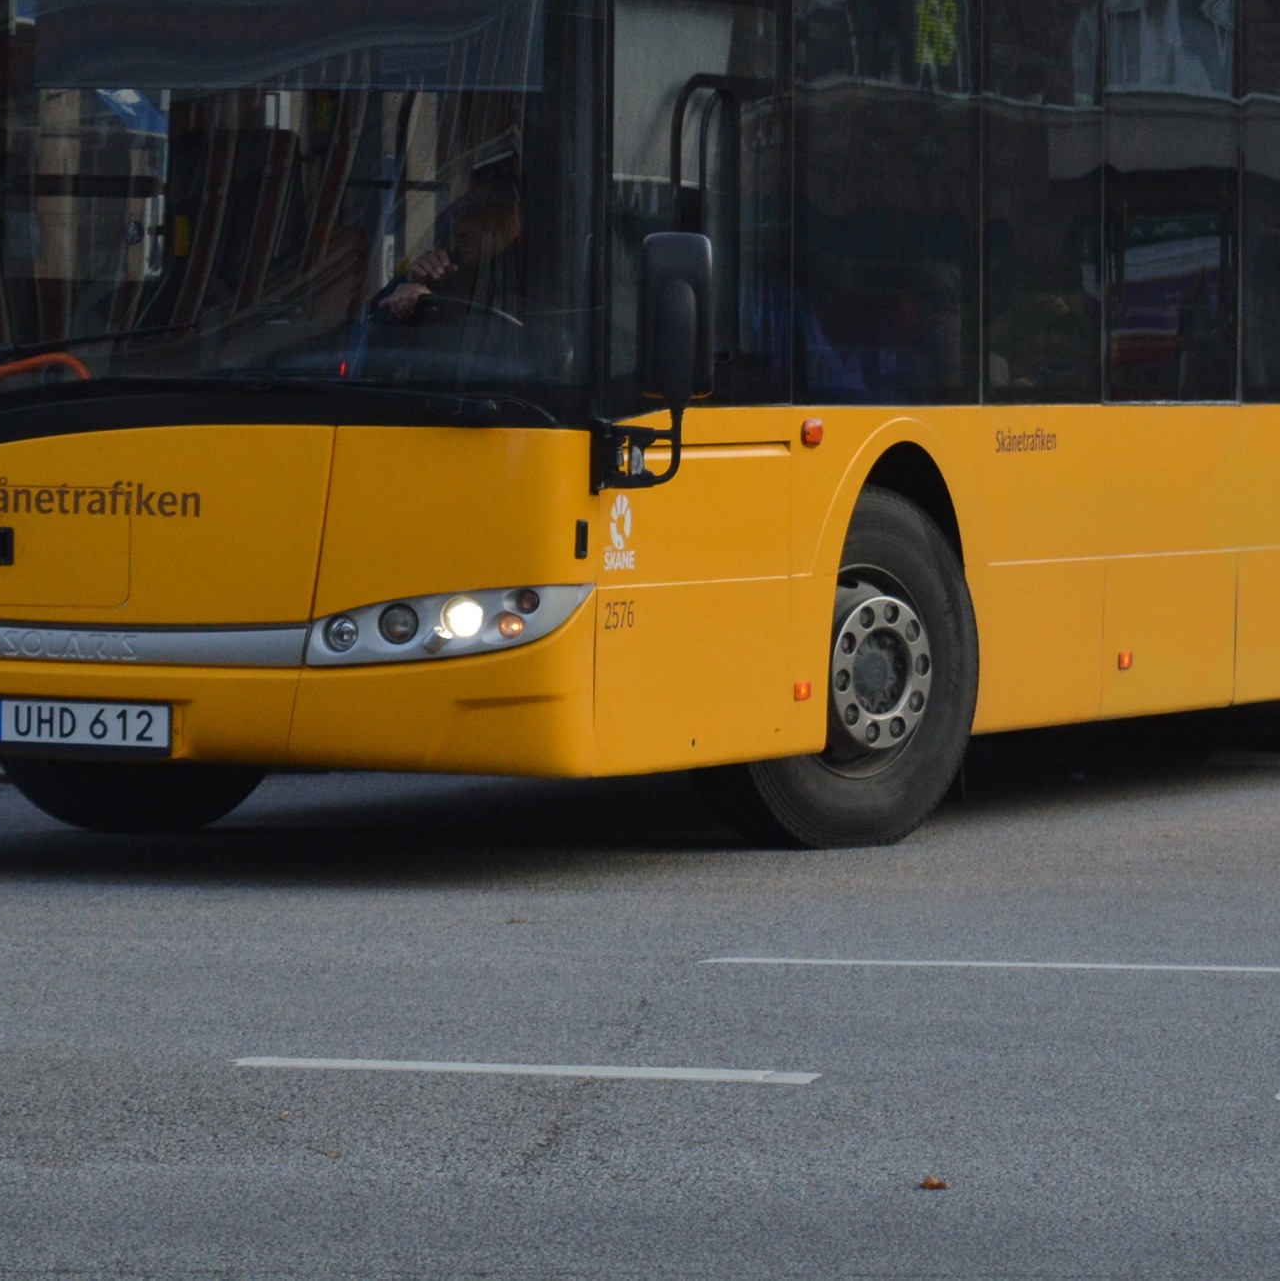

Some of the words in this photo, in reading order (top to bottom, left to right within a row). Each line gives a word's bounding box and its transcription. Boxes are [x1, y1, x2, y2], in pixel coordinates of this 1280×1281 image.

[995, 427, 1057, 454] Skånetrafiken
[604, 600, 634, 631] 2576
[2, 629, 139, 661] SOLARIS
[14, 704, 77, 739] UHD
[89, 707, 154, 743] 612
